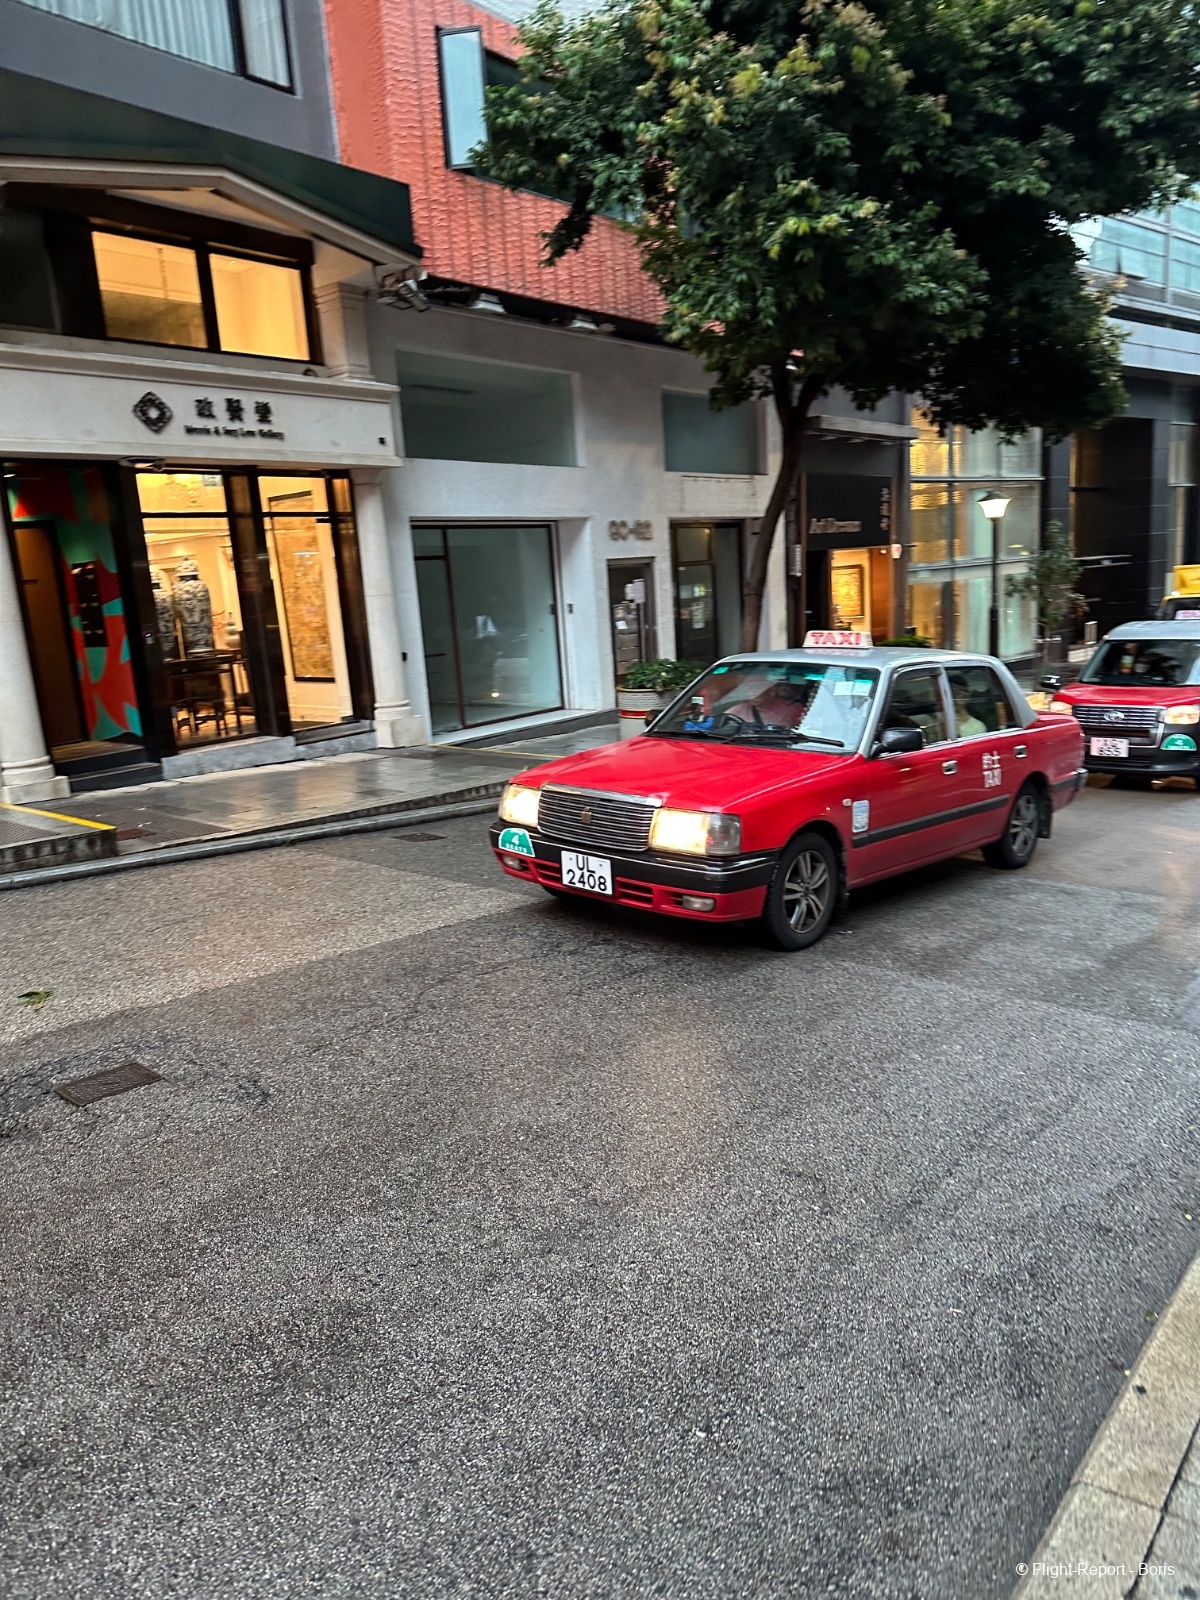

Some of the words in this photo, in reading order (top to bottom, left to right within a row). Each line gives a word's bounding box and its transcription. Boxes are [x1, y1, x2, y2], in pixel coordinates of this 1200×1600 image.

[810, 632, 861, 646] TAXI
[982, 768, 1002, 788] TAXI
[505, 842, 529, 854] SEATS
[510, 834, 520, 846] 4
[575, 854, 596, 874] UL
[566, 869, 607, 892] 2408
